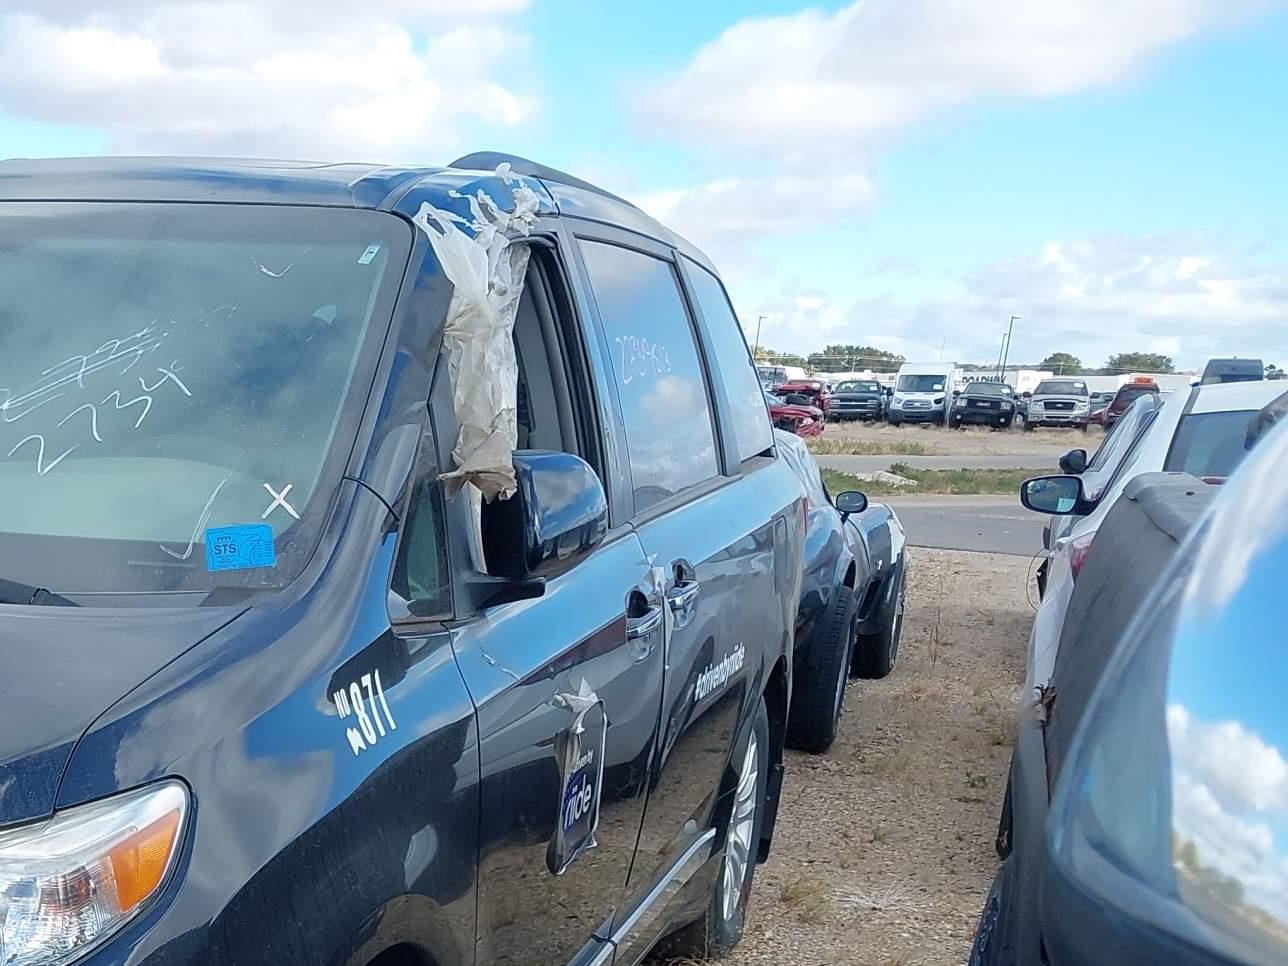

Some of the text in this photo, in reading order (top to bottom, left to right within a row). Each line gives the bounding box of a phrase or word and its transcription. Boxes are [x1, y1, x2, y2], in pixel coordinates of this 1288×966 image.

[8, 360, 192, 476] 2734
[214, 543, 237, 555] STS
[350, 668, 397, 745] 871
